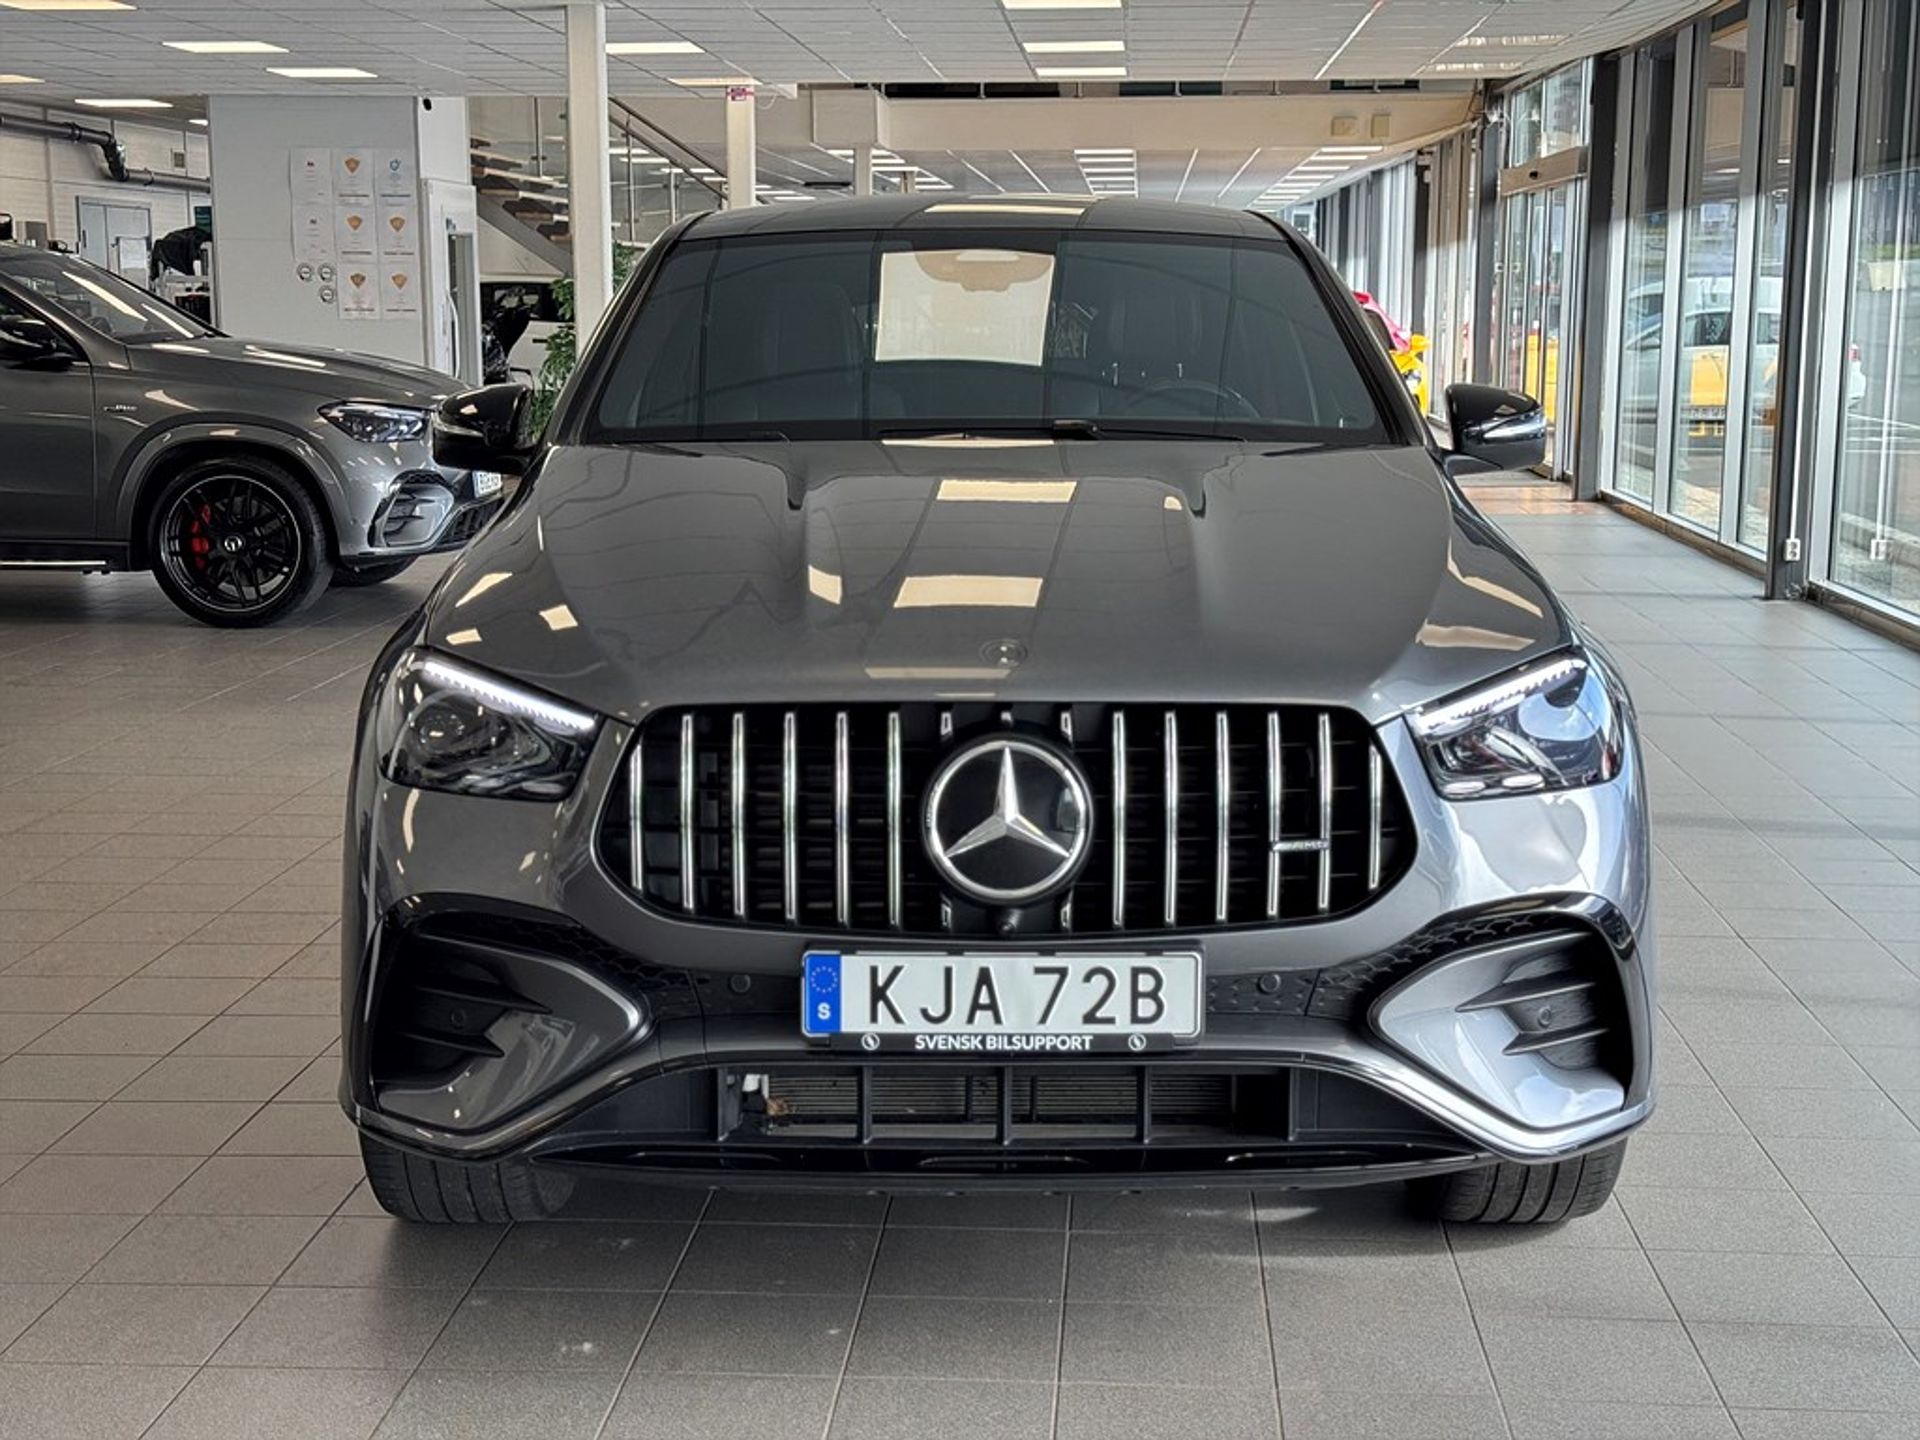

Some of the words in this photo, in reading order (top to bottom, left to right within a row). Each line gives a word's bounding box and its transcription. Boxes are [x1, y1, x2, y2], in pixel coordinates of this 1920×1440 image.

[869, 965, 1003, 1025] KJA
[1033, 965, 1165, 1025] 72B
[817, 1002, 831, 1020] S
[915, 1034, 983, 1050] SVENSK
[985, 1034, 1094, 1050] BILSUPPORT
